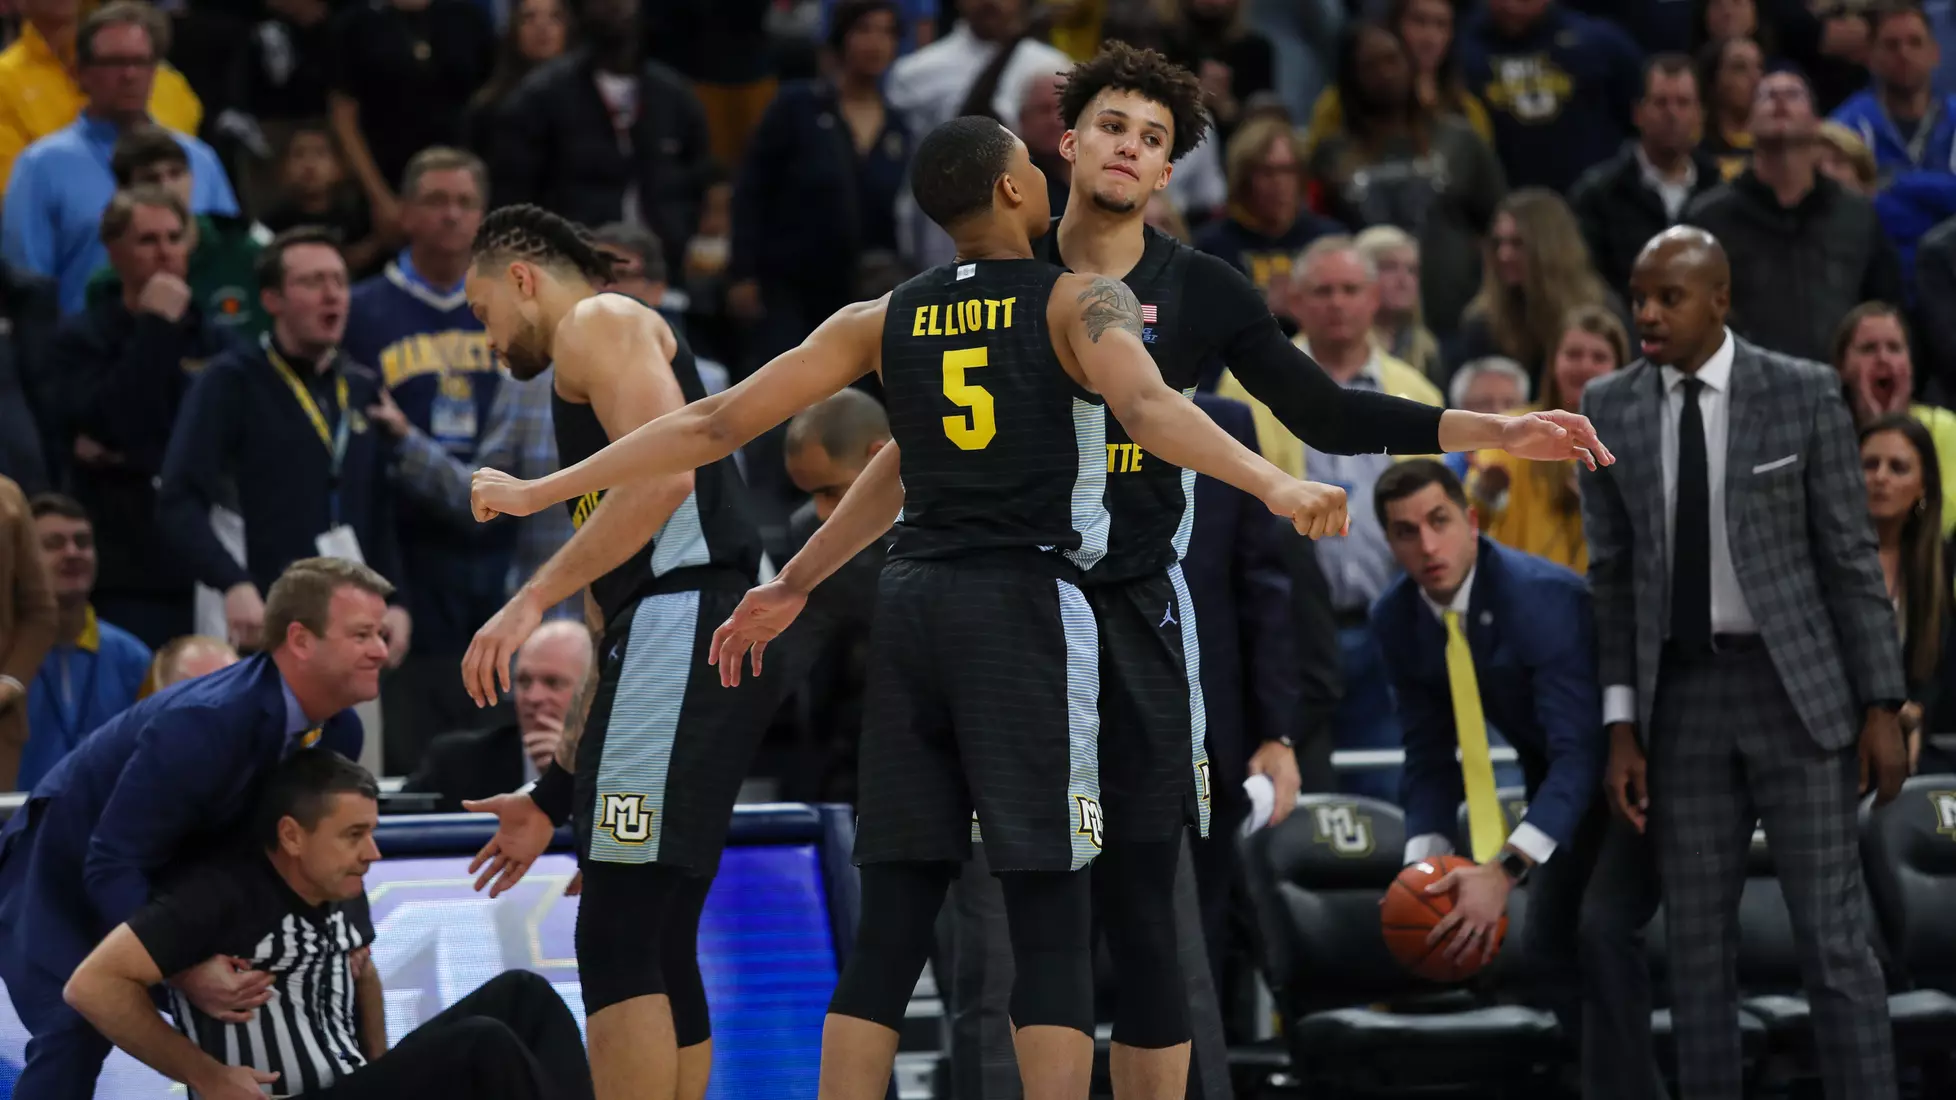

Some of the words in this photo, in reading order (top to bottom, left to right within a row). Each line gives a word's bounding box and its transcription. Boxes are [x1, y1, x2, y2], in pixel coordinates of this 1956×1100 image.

[912, 297, 1016, 336] ELLIOTT
[942, 346, 996, 450] 5
[597, 791, 655, 845] MU
[1307, 803, 1375, 857] MU
